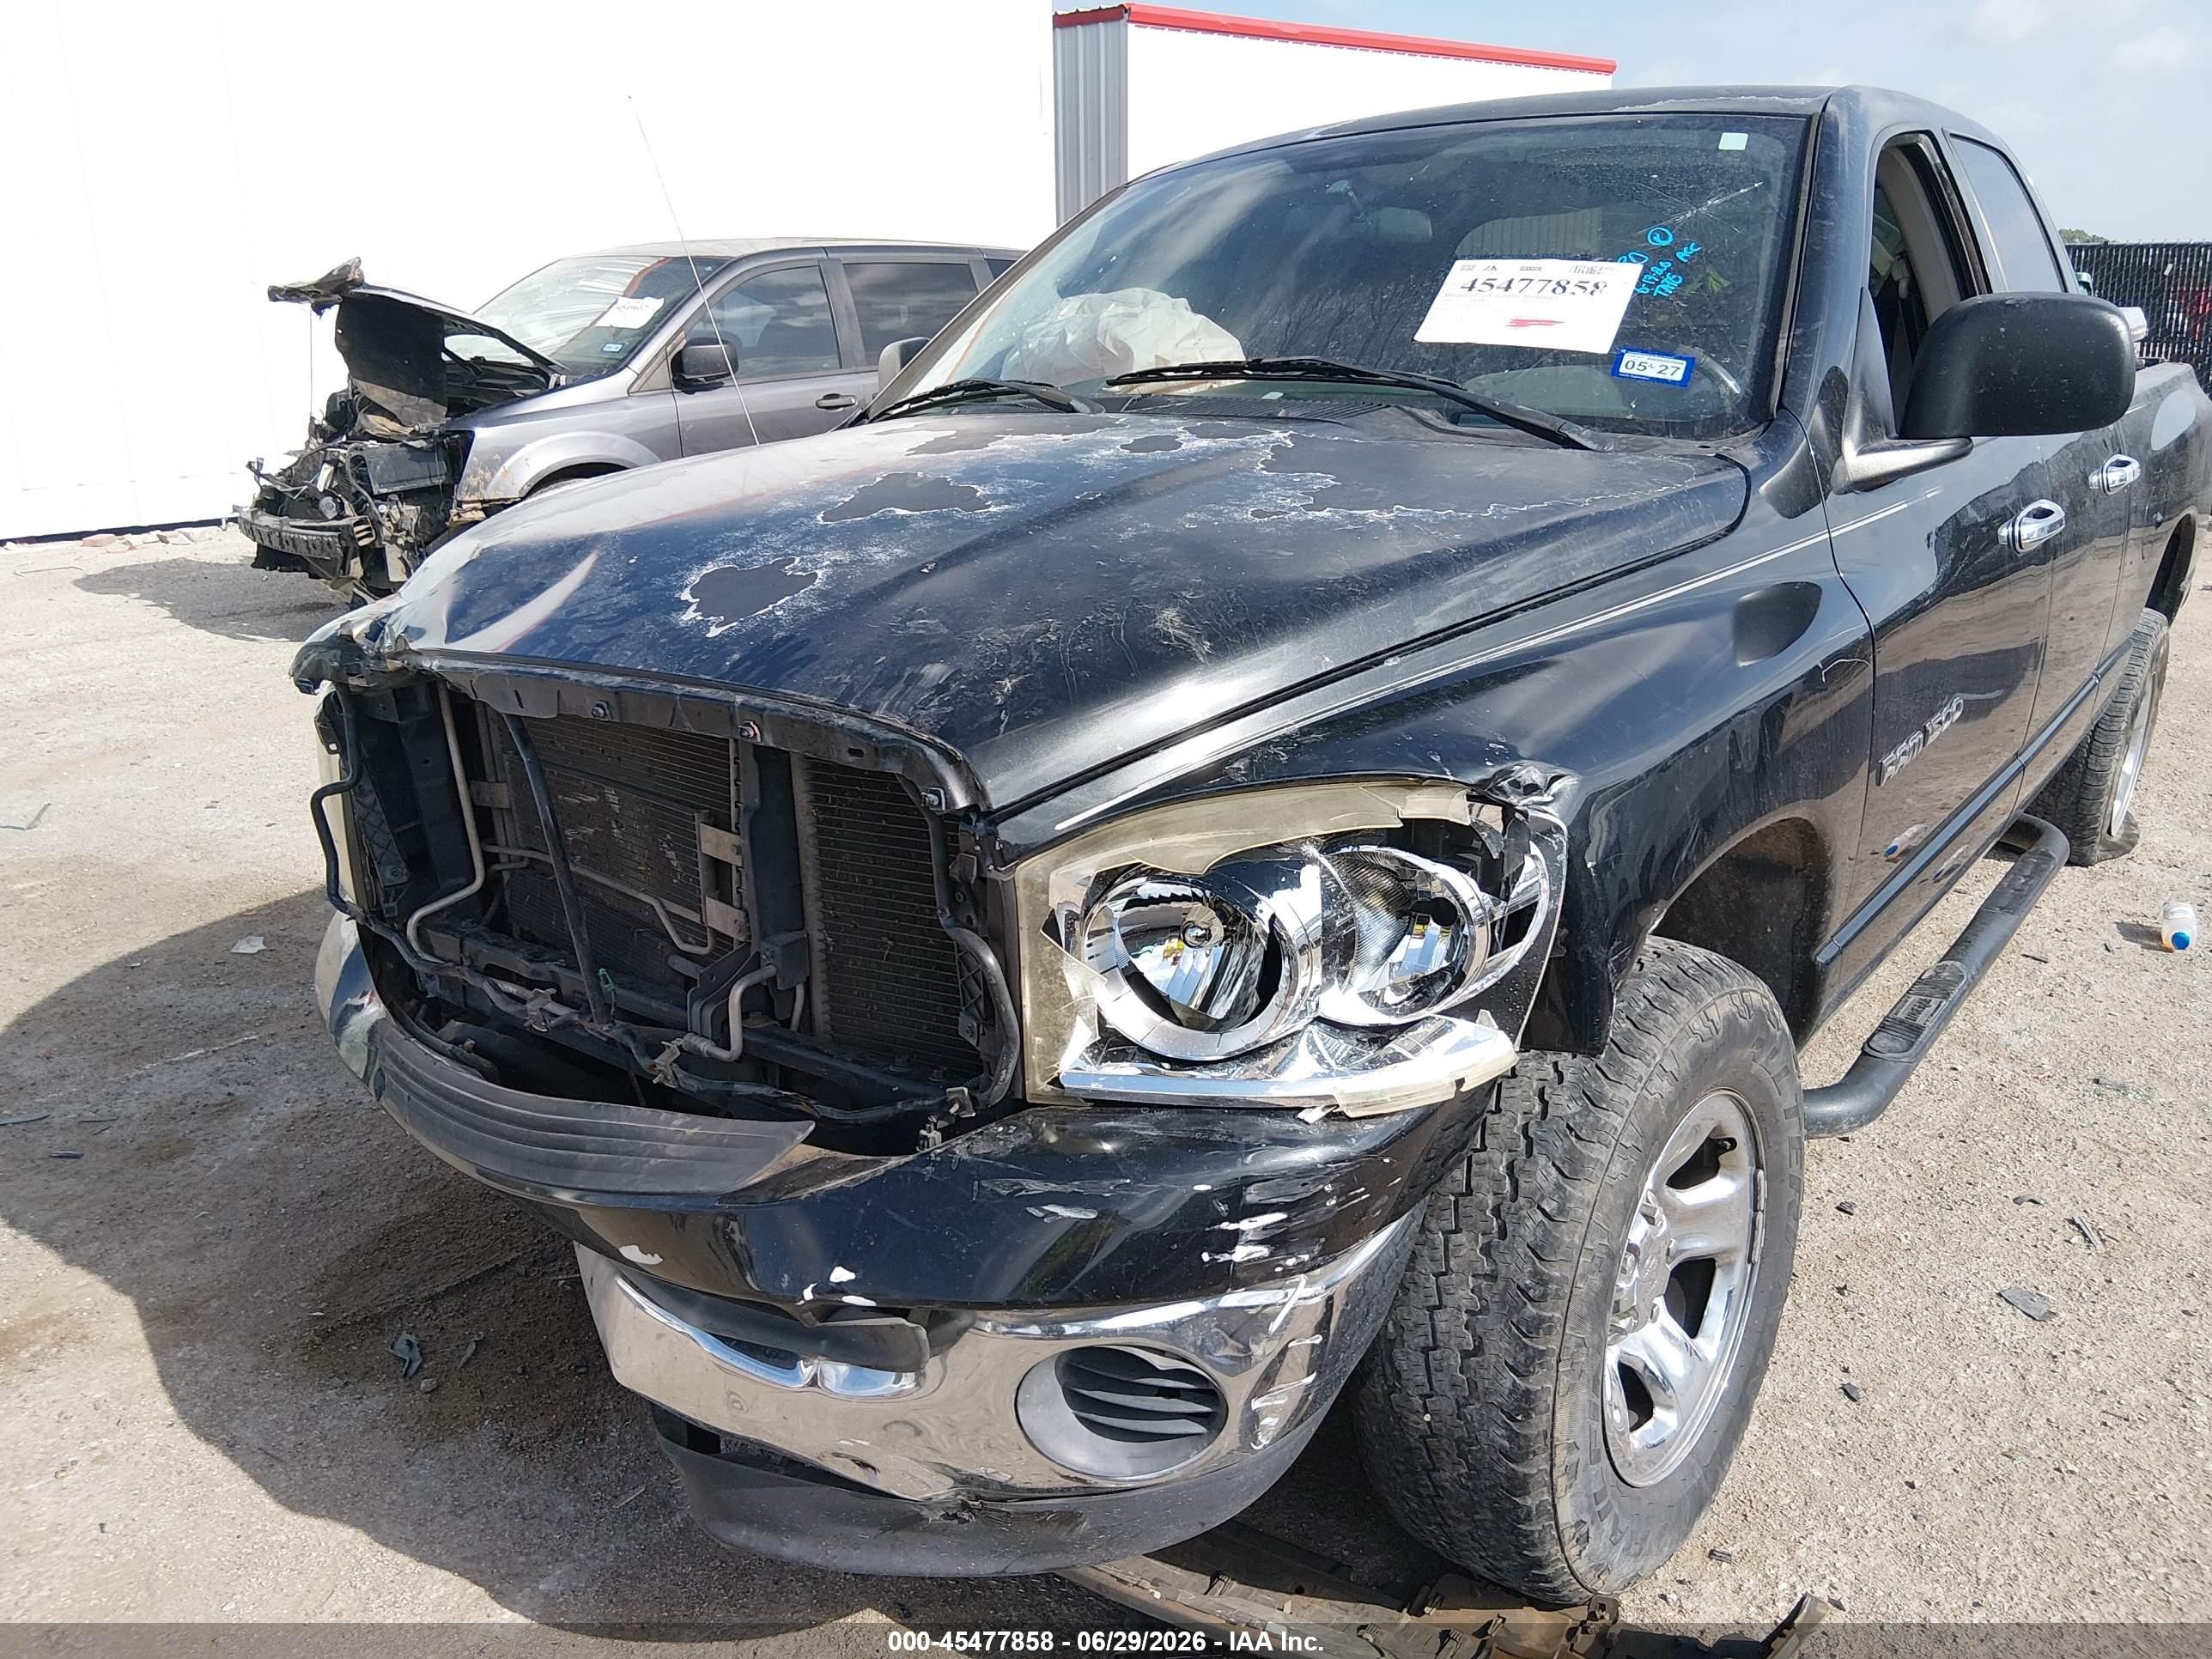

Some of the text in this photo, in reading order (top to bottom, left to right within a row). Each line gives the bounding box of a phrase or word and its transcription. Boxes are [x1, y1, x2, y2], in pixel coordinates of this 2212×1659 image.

[1460, 277, 1608, 296] 45477858
[1624, 360, 1682, 377] 05 27
[1923, 696, 1965, 747] 1500
